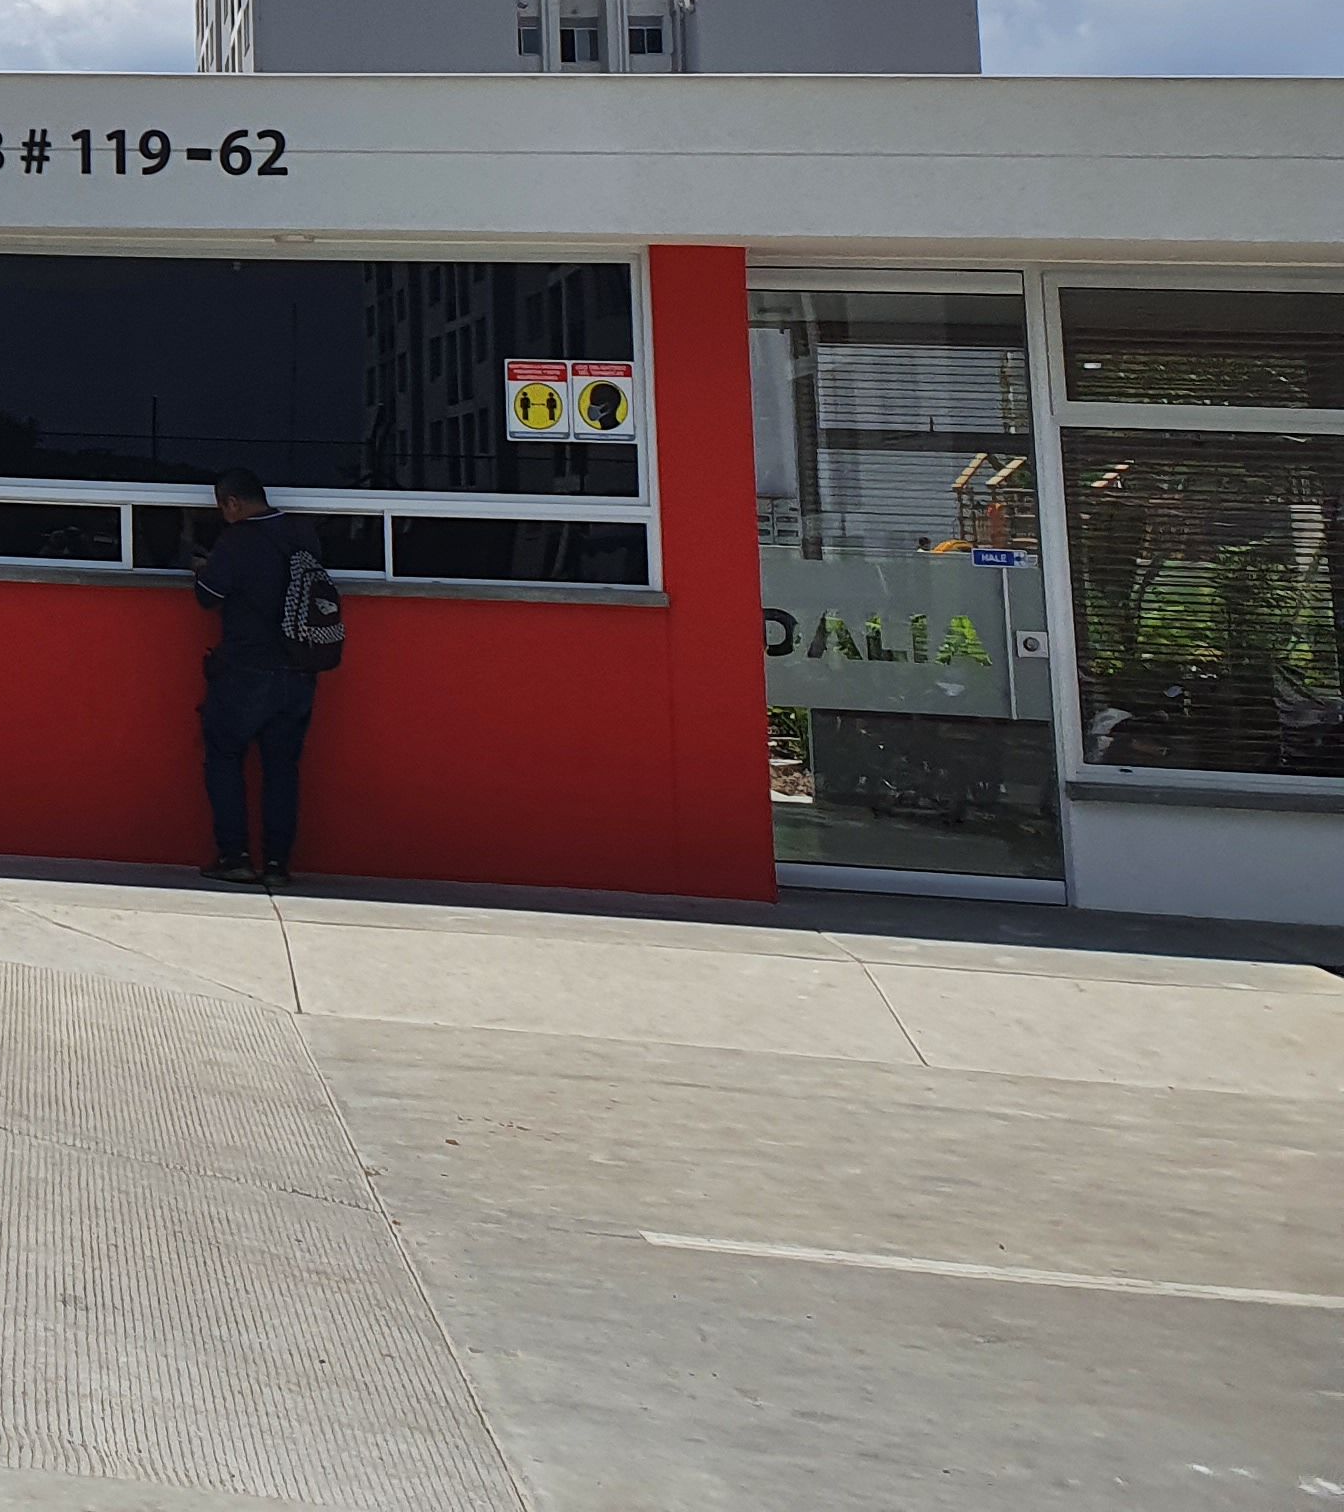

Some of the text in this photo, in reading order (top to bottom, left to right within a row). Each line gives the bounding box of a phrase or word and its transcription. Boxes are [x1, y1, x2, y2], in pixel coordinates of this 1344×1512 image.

[20, 128, 52, 175] #
[981, 553, 1007, 563] HALE
[763, 607, 992, 666] DALIA
